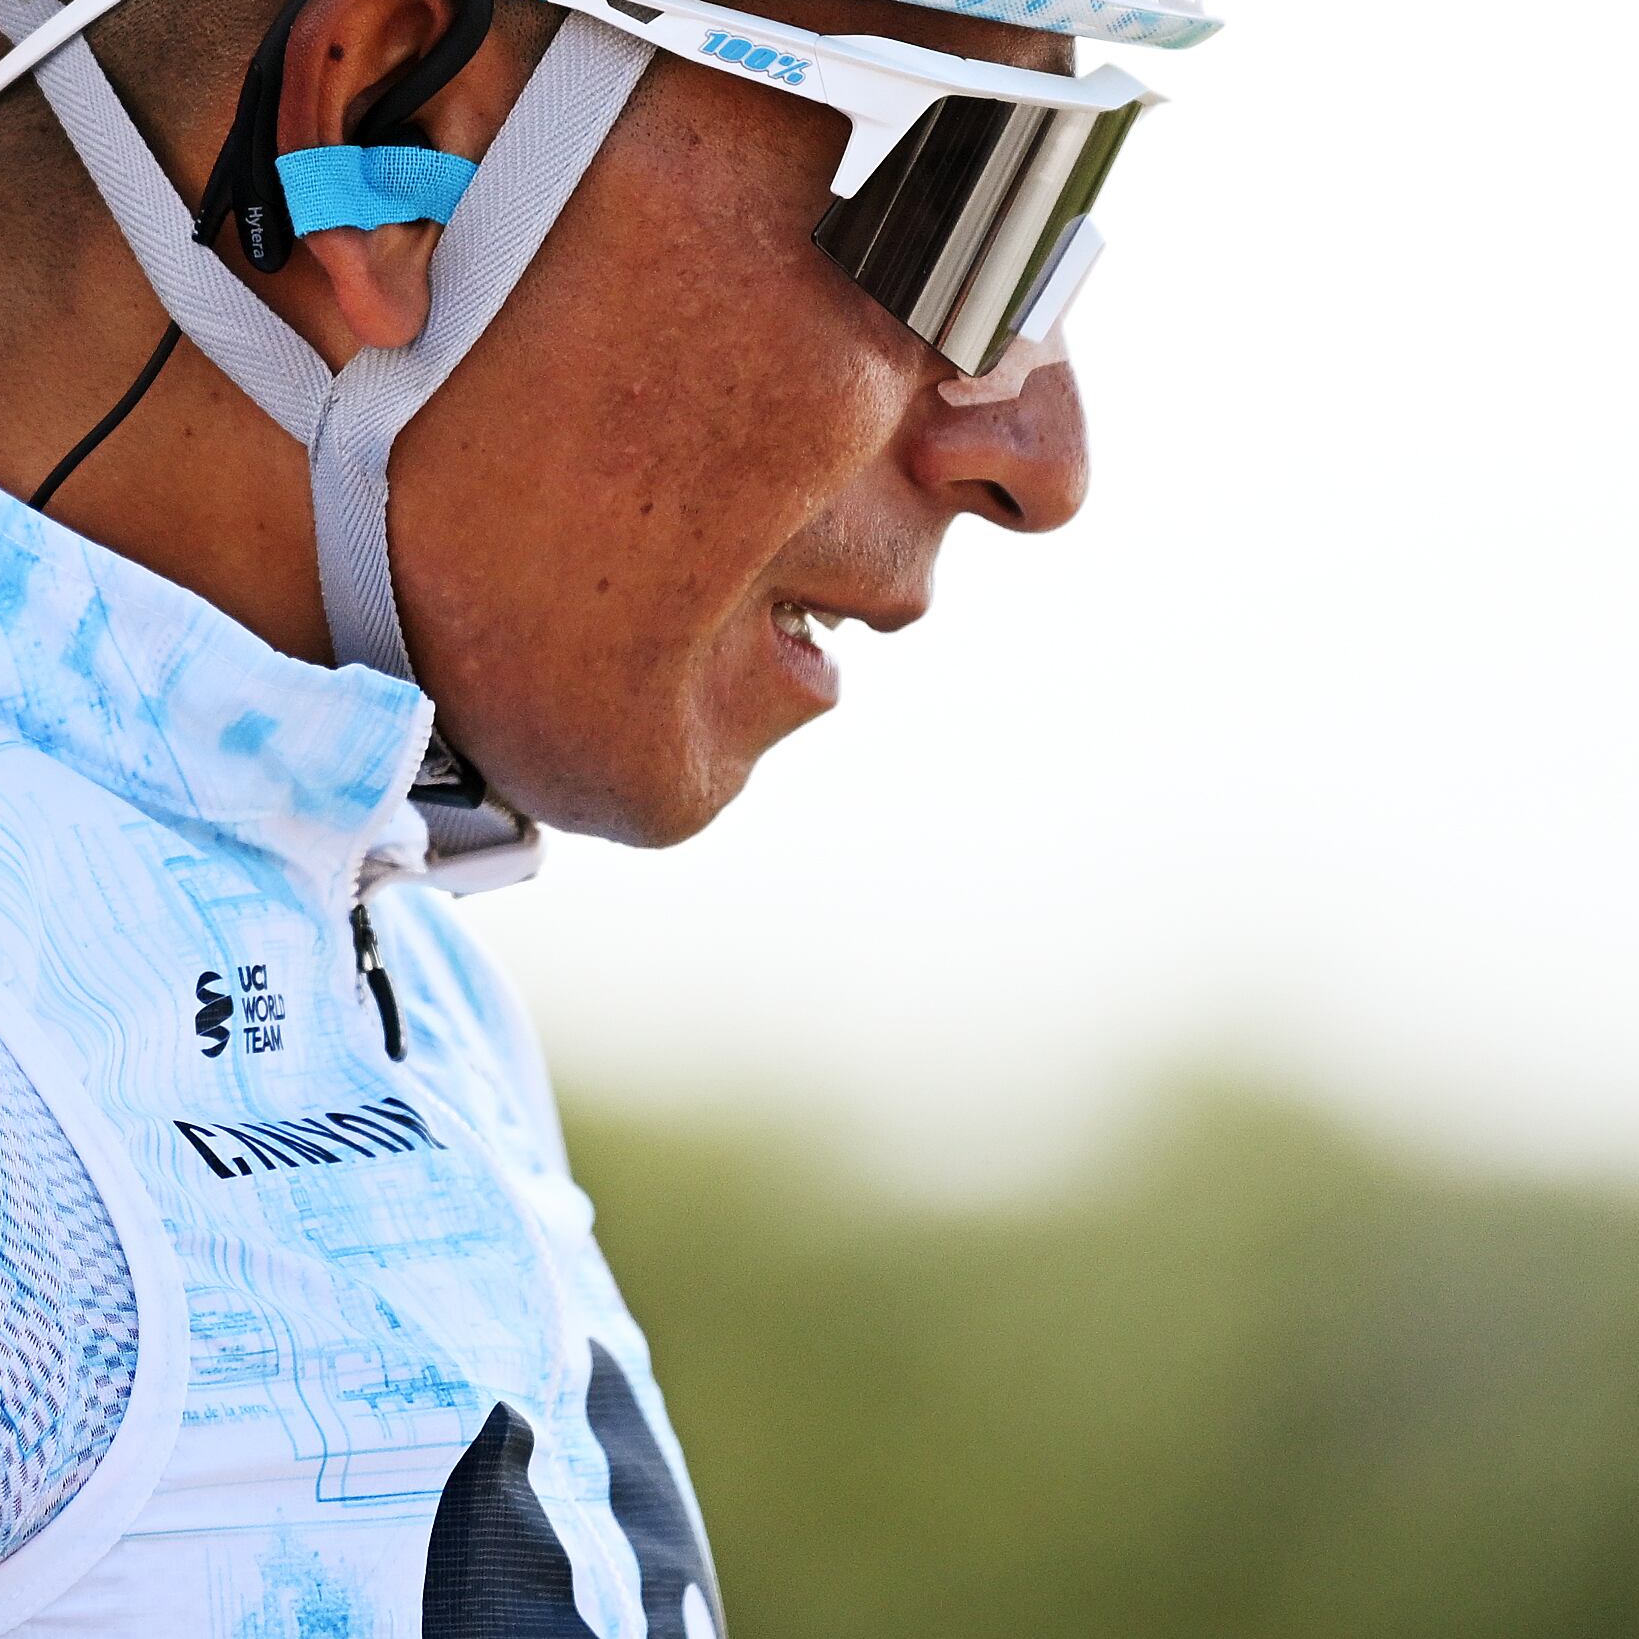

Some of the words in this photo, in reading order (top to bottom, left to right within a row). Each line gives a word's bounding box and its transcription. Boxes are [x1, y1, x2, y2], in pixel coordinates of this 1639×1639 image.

[699, 30, 811, 86] 100%
[245, 206, 264, 258] Hytera
[237, 964, 268, 993] UCI
[241, 994, 286, 1024] WORLD
[242, 1024, 284, 1055] TEAM
